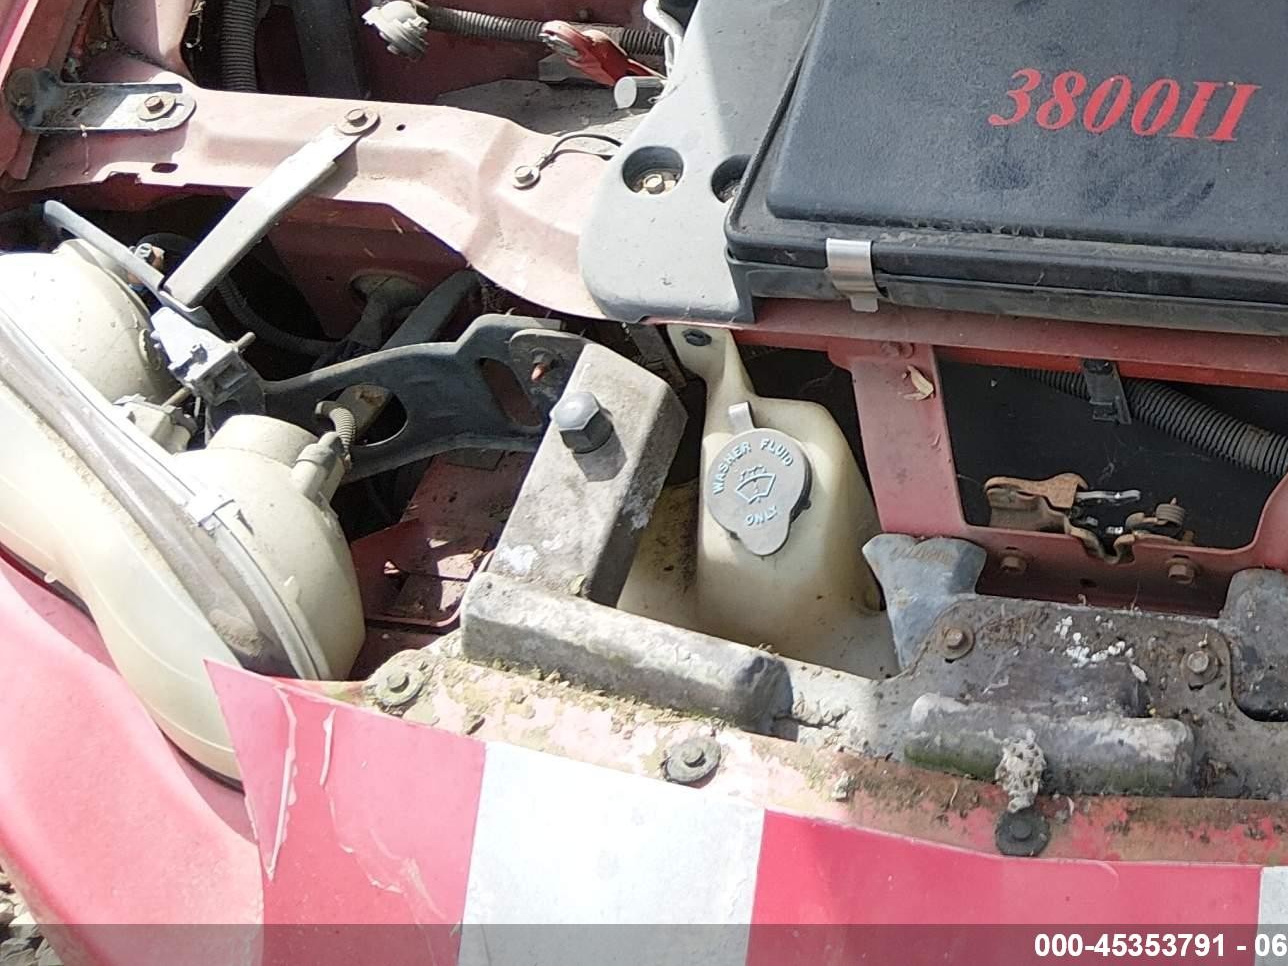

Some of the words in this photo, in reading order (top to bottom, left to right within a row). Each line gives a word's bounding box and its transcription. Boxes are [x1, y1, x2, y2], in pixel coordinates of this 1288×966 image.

[712, 441, 752, 495] WASHER
[760, 438, 794, 467] FLUID
[745, 505, 778, 526] ONLY
